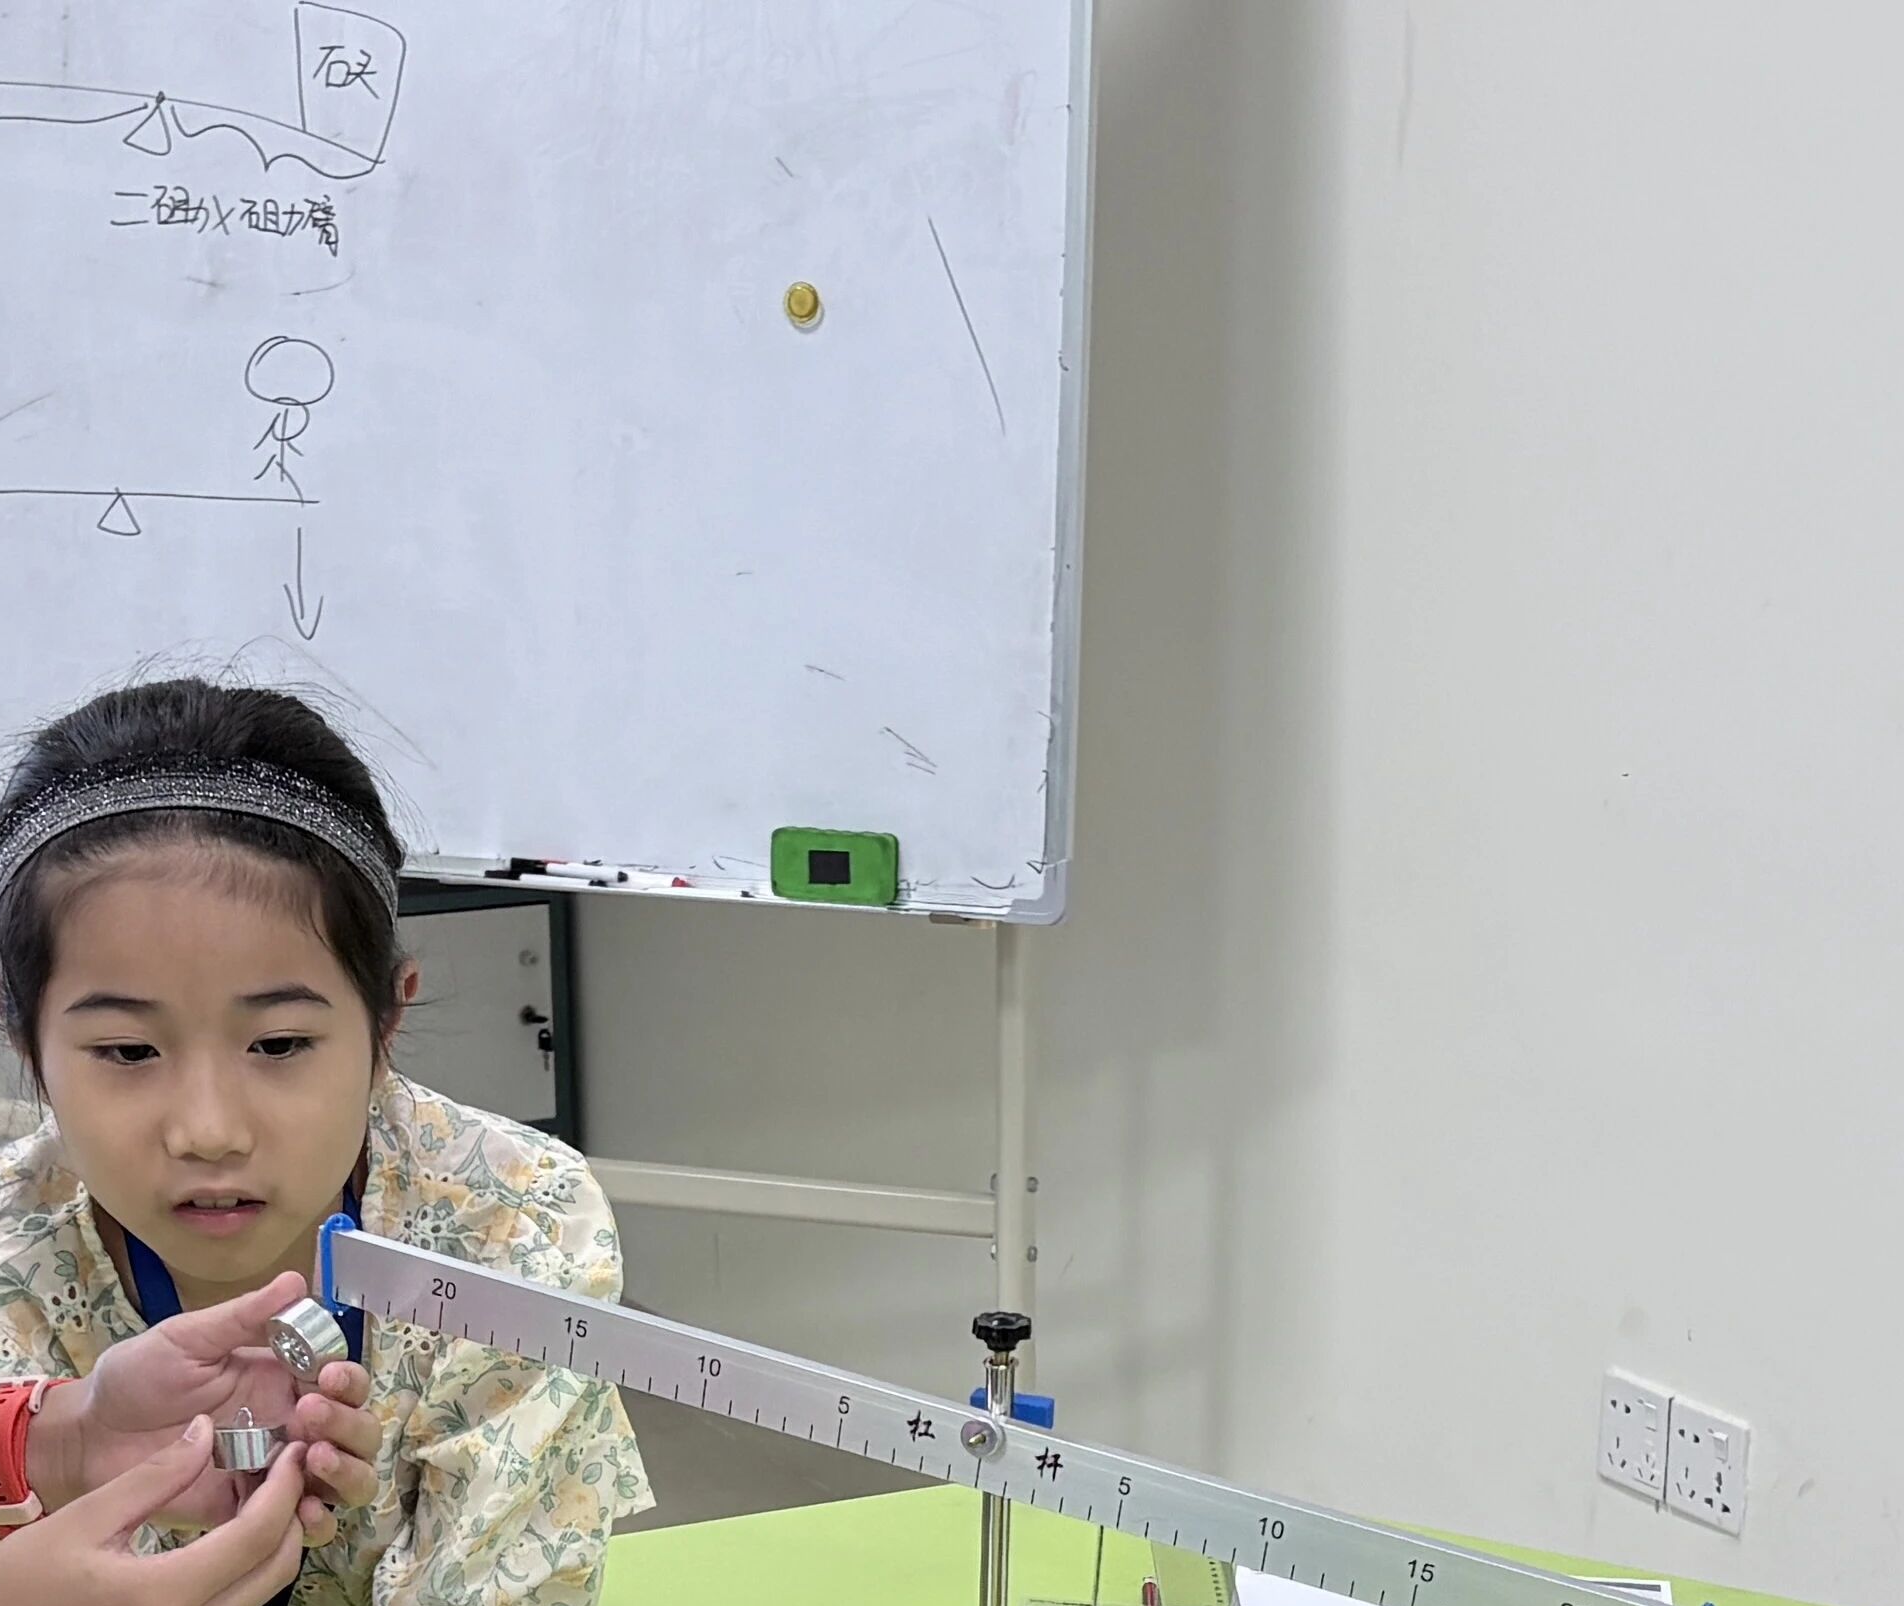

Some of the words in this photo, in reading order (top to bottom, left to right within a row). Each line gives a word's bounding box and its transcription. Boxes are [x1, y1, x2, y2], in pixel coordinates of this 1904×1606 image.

[314, 44, 379, 101] 石头
[432, 1278, 456, 1300] 20
[563, 1316, 587, 1339] 15
[697, 1355, 721, 1378] 10
[837, 1396, 850, 1415] 5
[1118, 1477, 1131, 1496] 5
[1258, 1516, 1285, 1541] 10
[1406, 1558, 1435, 1584] 15
[906, 1410, 935, 1442] 杠
[1035, 1447, 1064, 1480] 杆
